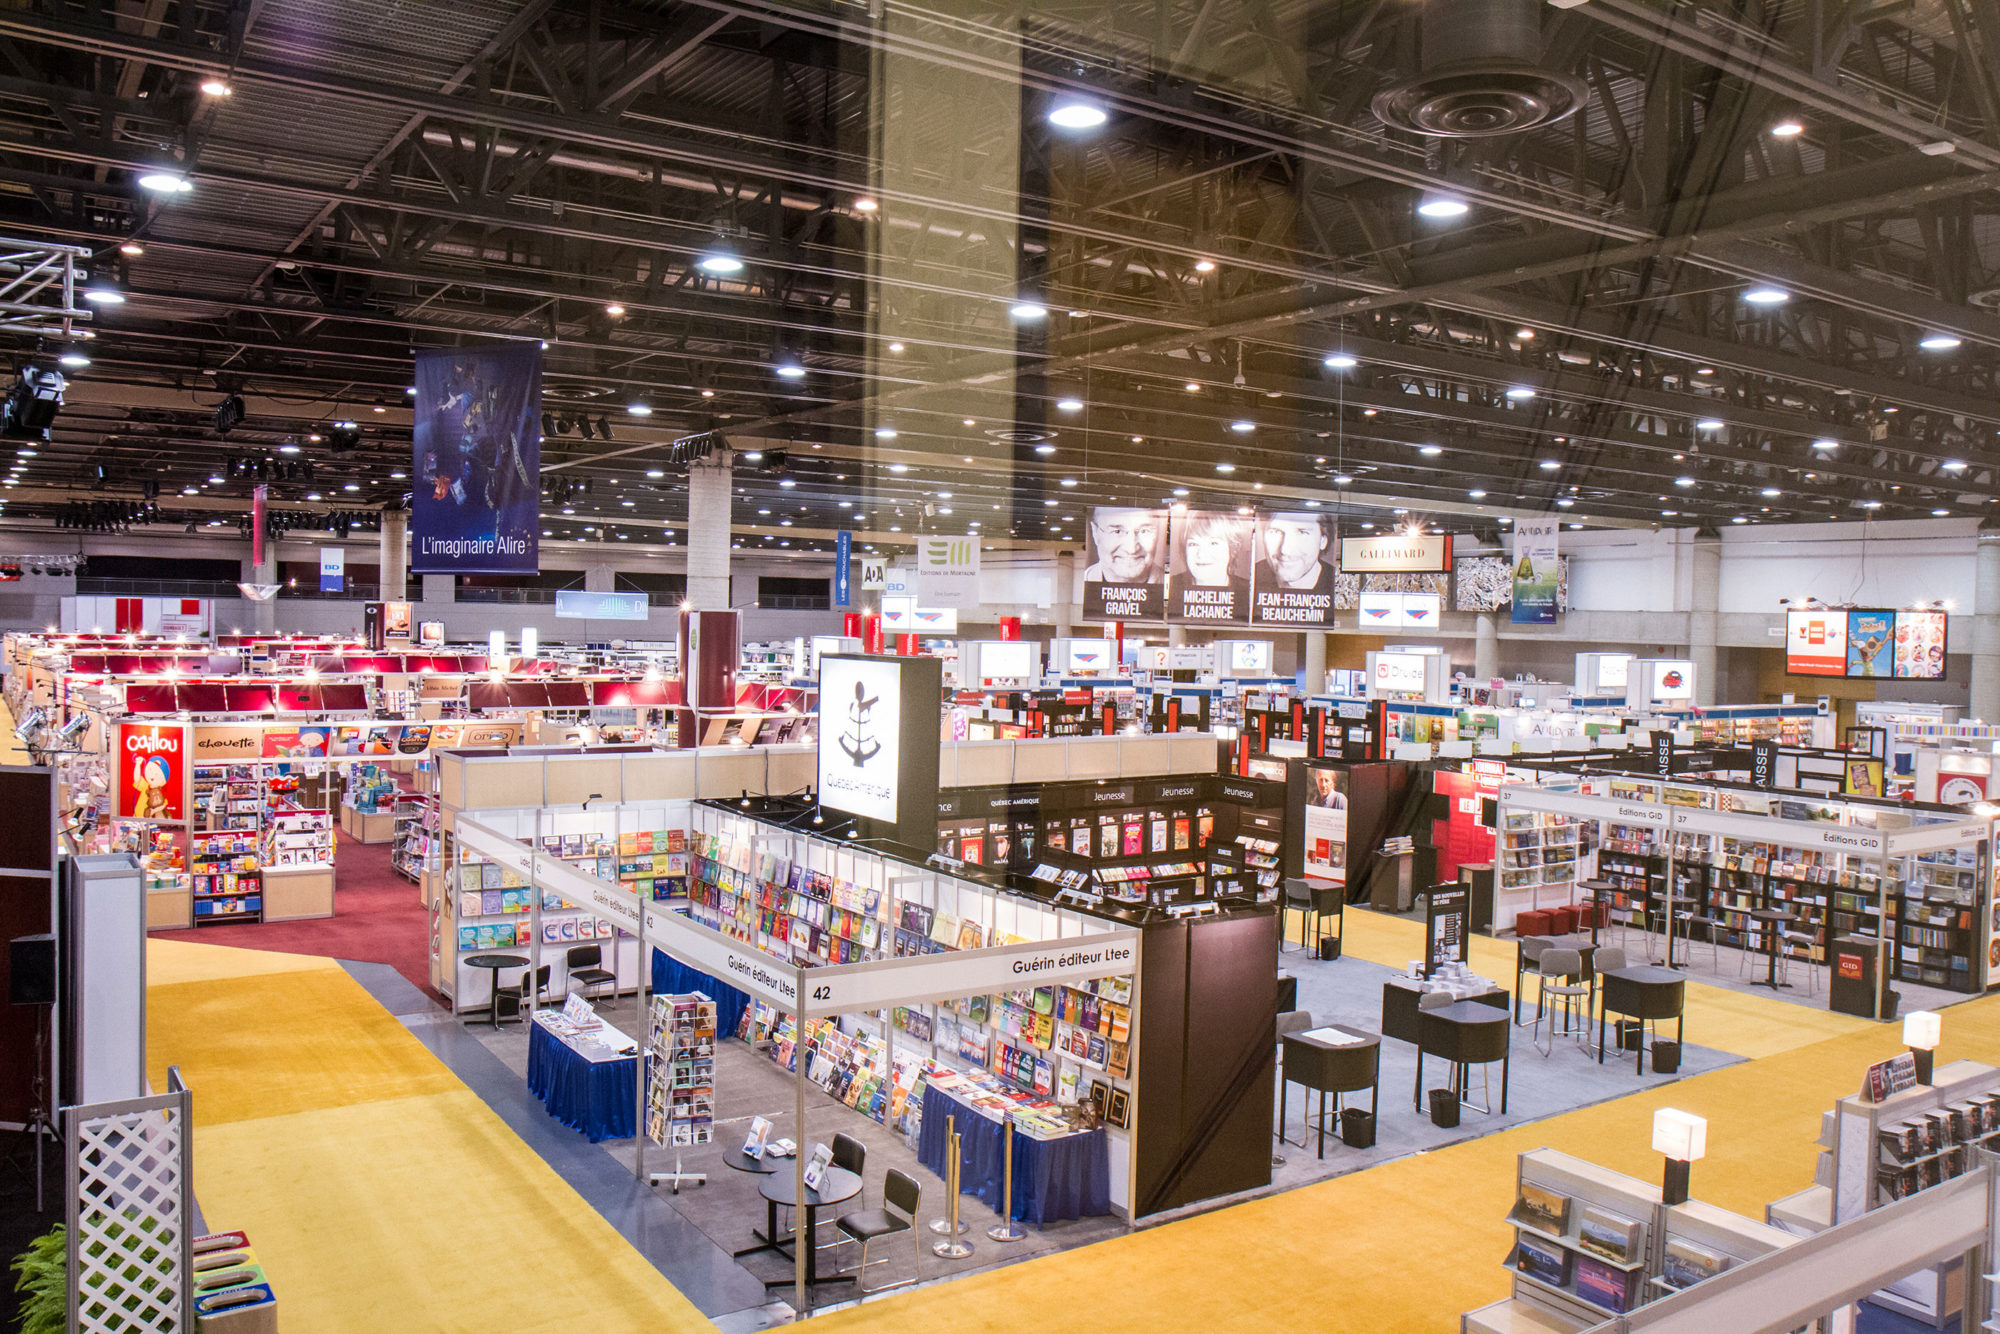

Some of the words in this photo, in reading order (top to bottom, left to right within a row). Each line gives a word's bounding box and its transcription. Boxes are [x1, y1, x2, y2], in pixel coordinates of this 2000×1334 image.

[422, 536, 494, 558] L'imaginaire
[497, 536, 526, 554] Alire
[1360, 548, 1425, 559] GALLIMARD
[887, 583, 905, 591] BD
[1101, 587, 1147, 603] FRANÇOIS
[1183, 590, 1235, 605] MICHELINE
[1256, 592, 1331, 612] JEAN-FRANÇOIS
[1105, 602, 1142, 616] GRAVEL
[1183, 605, 1233, 619] LACHANCE
[1262, 607, 1325, 622] BEAUCHEMIN
[1658, 738, 1670, 775] AISSE
[1755, 746, 1769, 786] AISSE
[1094, 791, 1126, 801] Jeunesse
[1161, 786, 1194, 797] Jeunesse
[1224, 786, 1254, 799] Jeunesse
[1503, 792, 1512, 800] 37
[938, 803, 952, 812] nce
[990, 798, 1012, 807] QUÉBEC
[1012, 797, 1040, 805] AMÉRIQUE
[1648, 811, 1663, 820] GID
[1677, 815, 1687, 823] 37
[1823, 832, 1858, 846] Éditions
[1860, 838, 1878, 848] GID
[592, 889, 609, 904] Guérin
[609, 898, 628, 915] éditeur
[627, 905, 640, 921] Ltee
[646, 915, 654, 928] 42
[1012, 956, 1055, 973] Guérin
[1058, 952, 1101, 967] éditeur
[1105, 948, 1130, 960] Ltee
[1842, 961, 1858, 970] GID
[727, 955, 751, 977] Guérin
[752, 965, 778, 990] éditeur
[779, 978, 796, 998] Ltee
[813, 986, 831, 1000] 42
